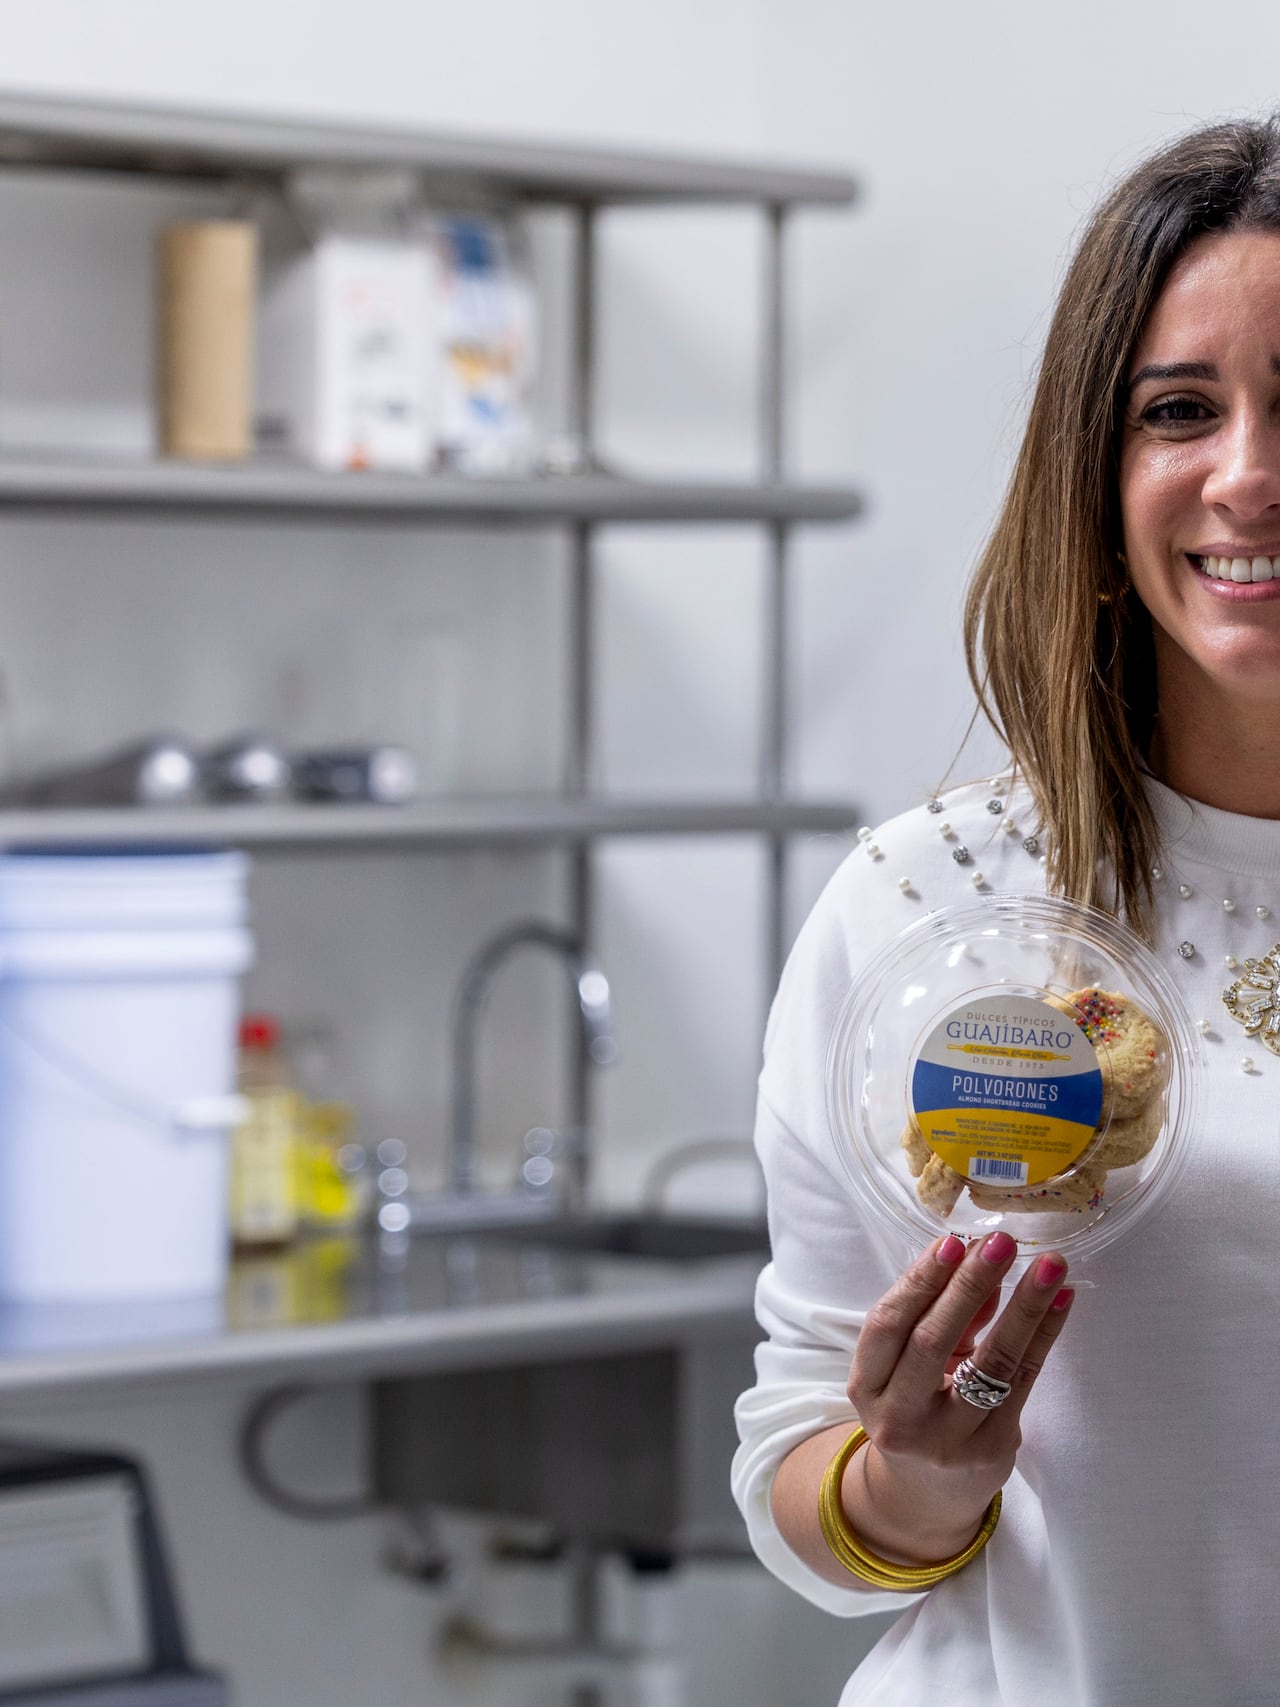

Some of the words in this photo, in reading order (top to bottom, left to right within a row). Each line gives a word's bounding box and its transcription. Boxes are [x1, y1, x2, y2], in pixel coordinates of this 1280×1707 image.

[966, 1011, 1008, 1024] DULCES
[946, 1021, 1073, 1049] GUAJÍBARO
[971, 1056, 1013, 1067] DESDE
[952, 1075, 1059, 1102] POLVORONES
[957, 1095, 982, 1104] ALMOND
[983, 1097, 1020, 1108] SHORTBREAD
[1021, 1101, 1047, 1110] COOKIES
